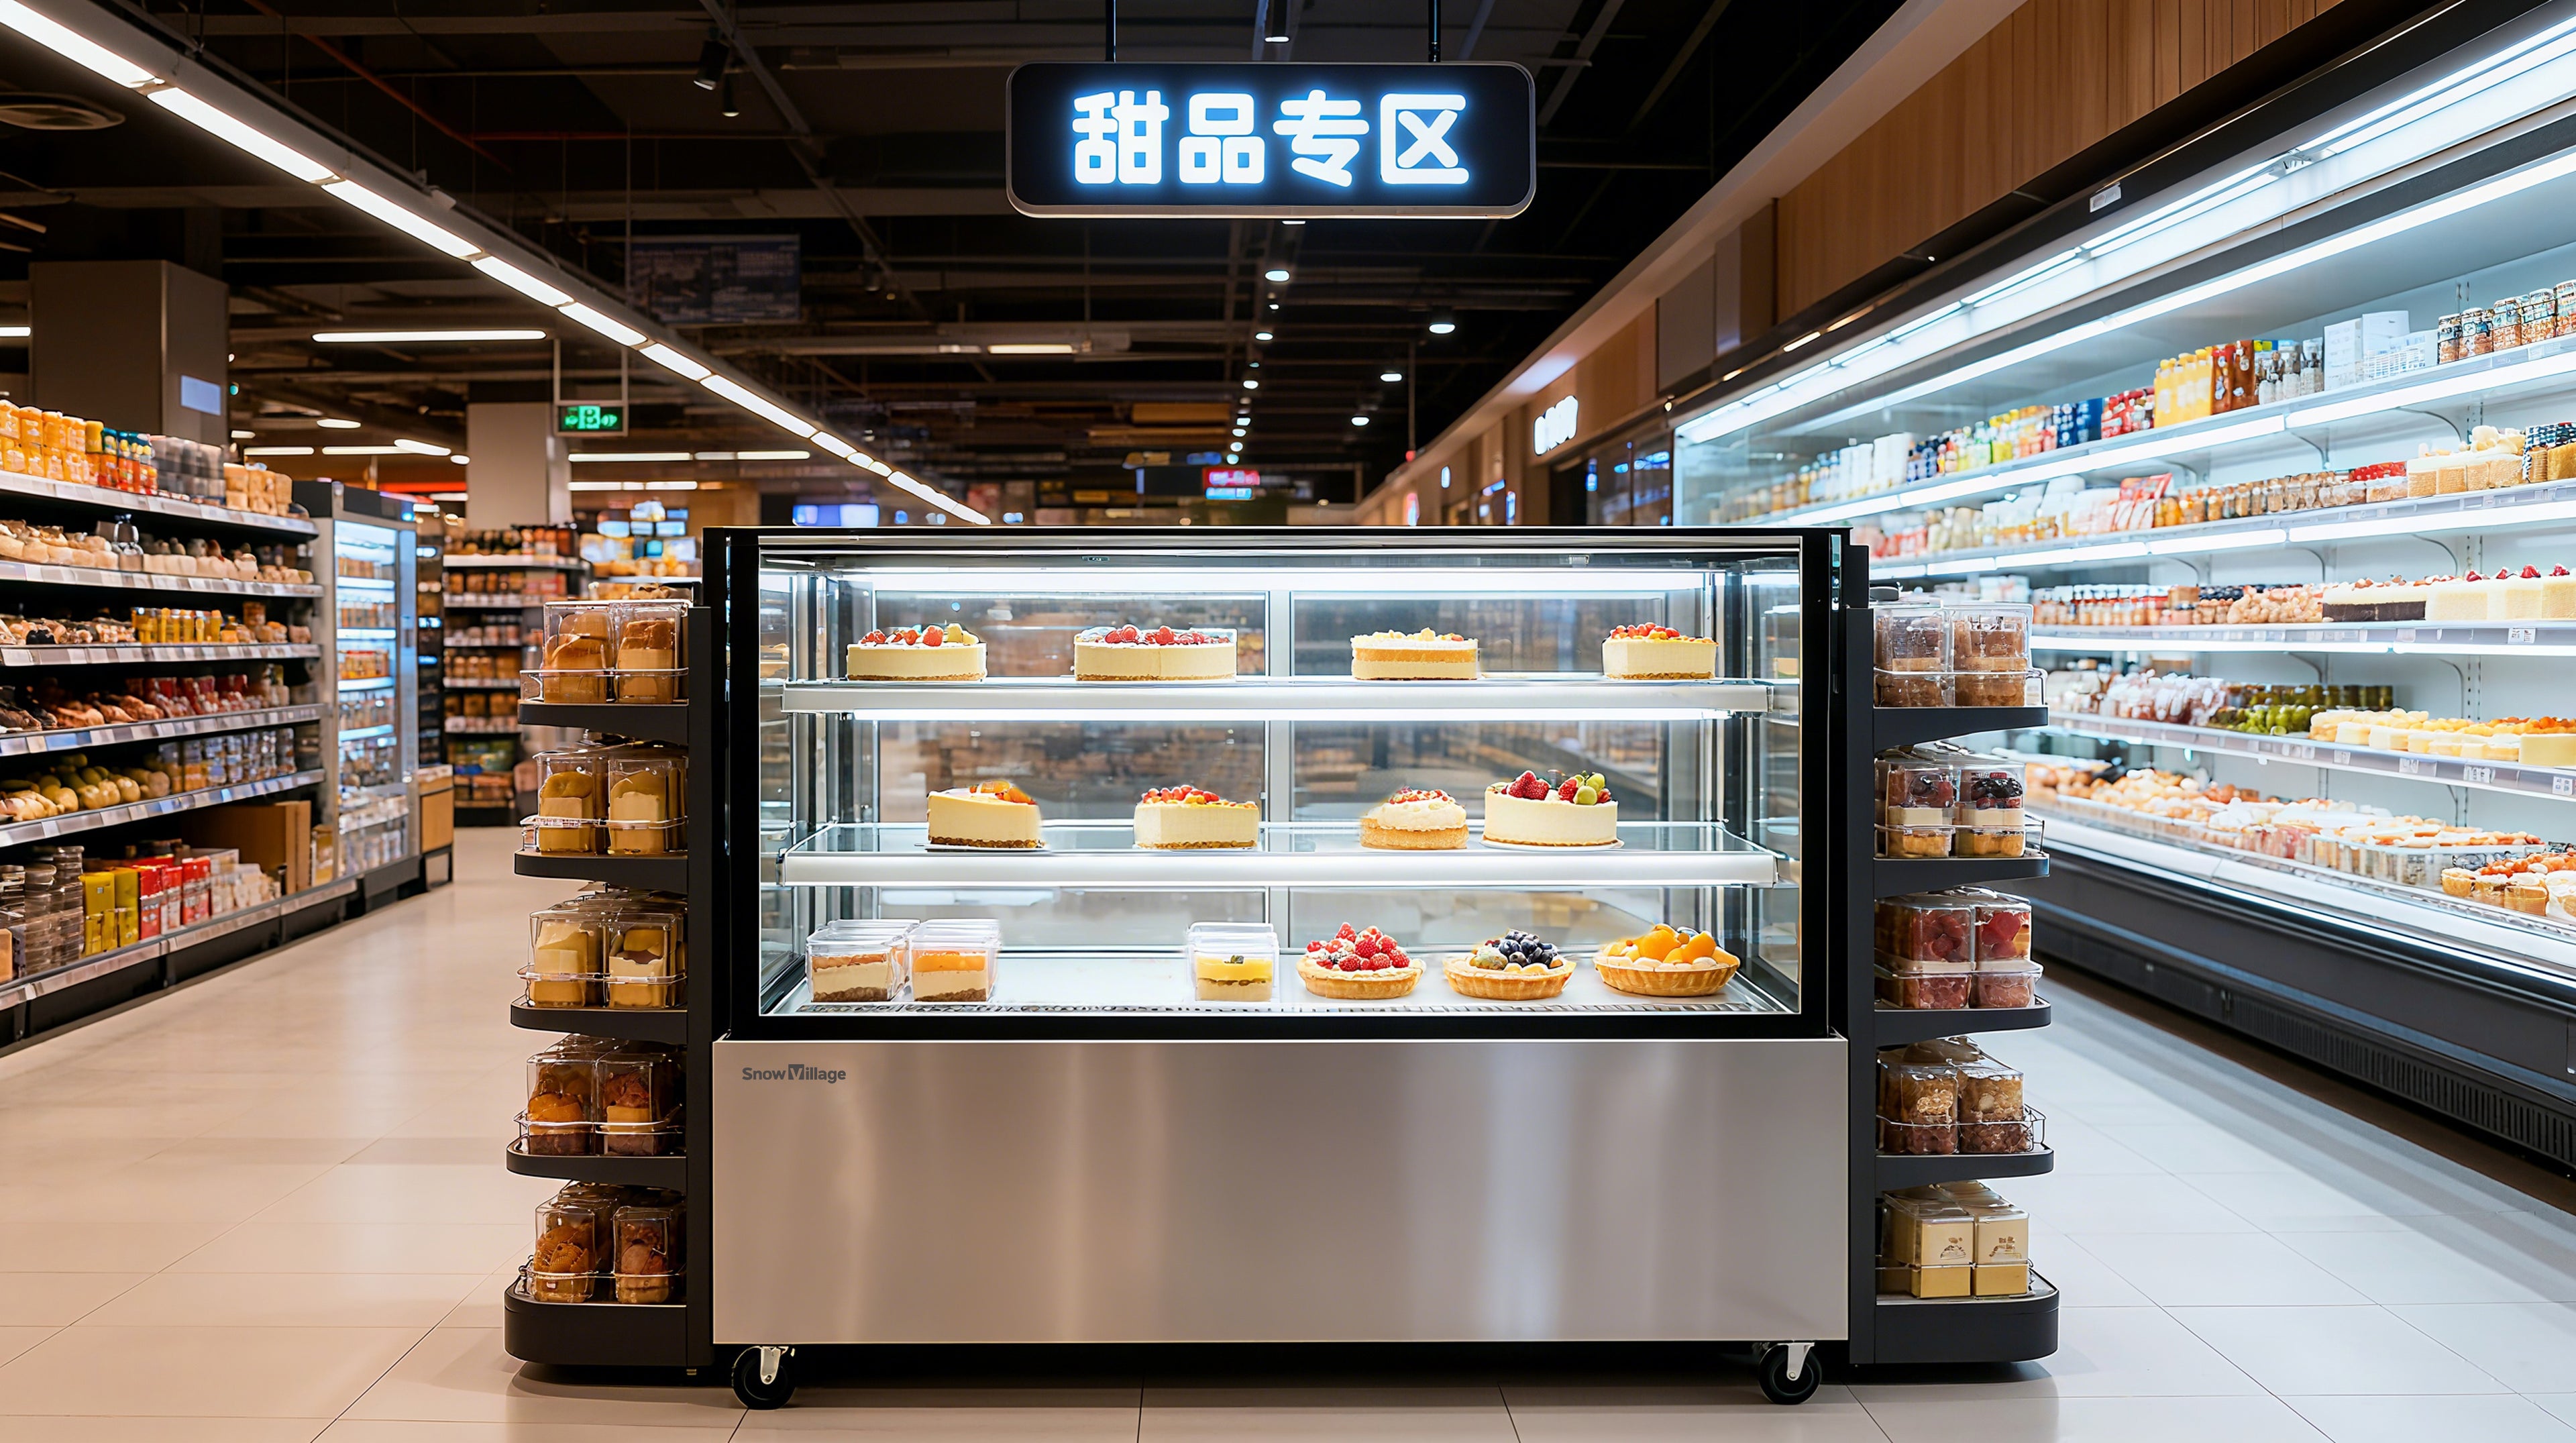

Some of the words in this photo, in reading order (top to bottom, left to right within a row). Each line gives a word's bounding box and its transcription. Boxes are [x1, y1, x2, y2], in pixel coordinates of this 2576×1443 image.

[1073, 89, 1470, 187] 甜品专区
[742, 1067, 786, 1081] Snow
[788, 1064, 847, 1084] Village
